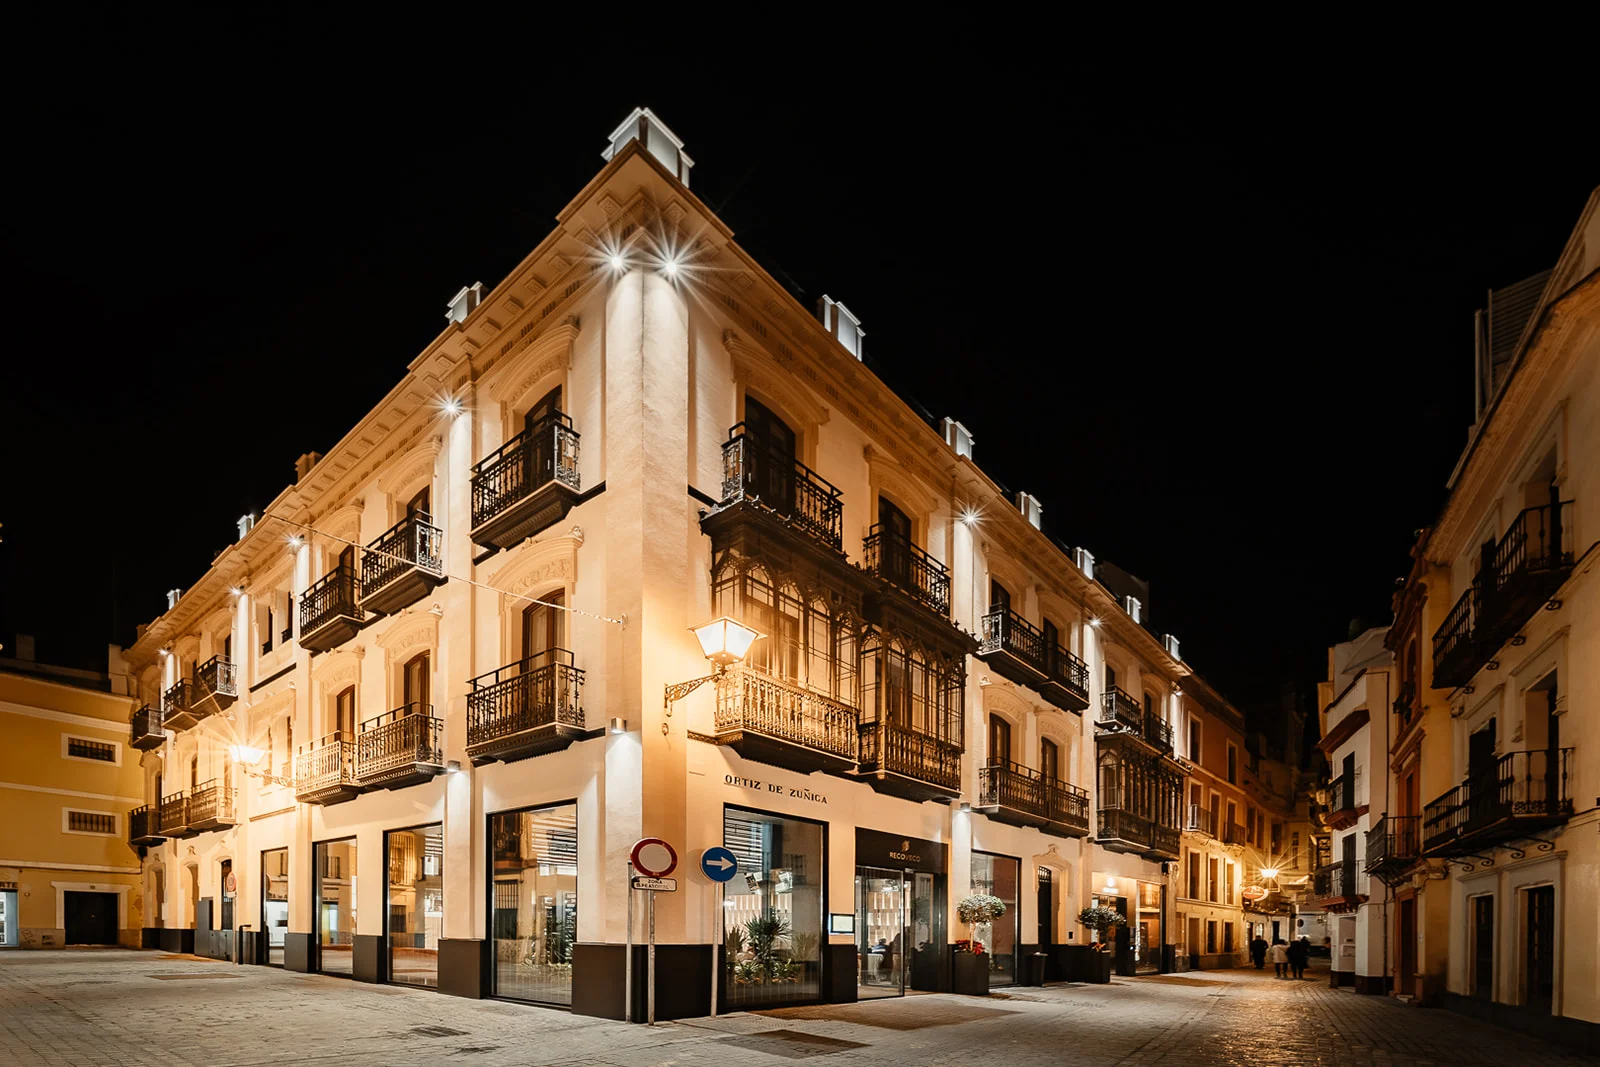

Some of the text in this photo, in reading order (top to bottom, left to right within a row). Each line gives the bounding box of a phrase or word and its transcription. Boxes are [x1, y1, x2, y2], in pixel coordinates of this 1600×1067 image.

[725, 774, 828, 804] ORTIZ DE ZUÑIGA
